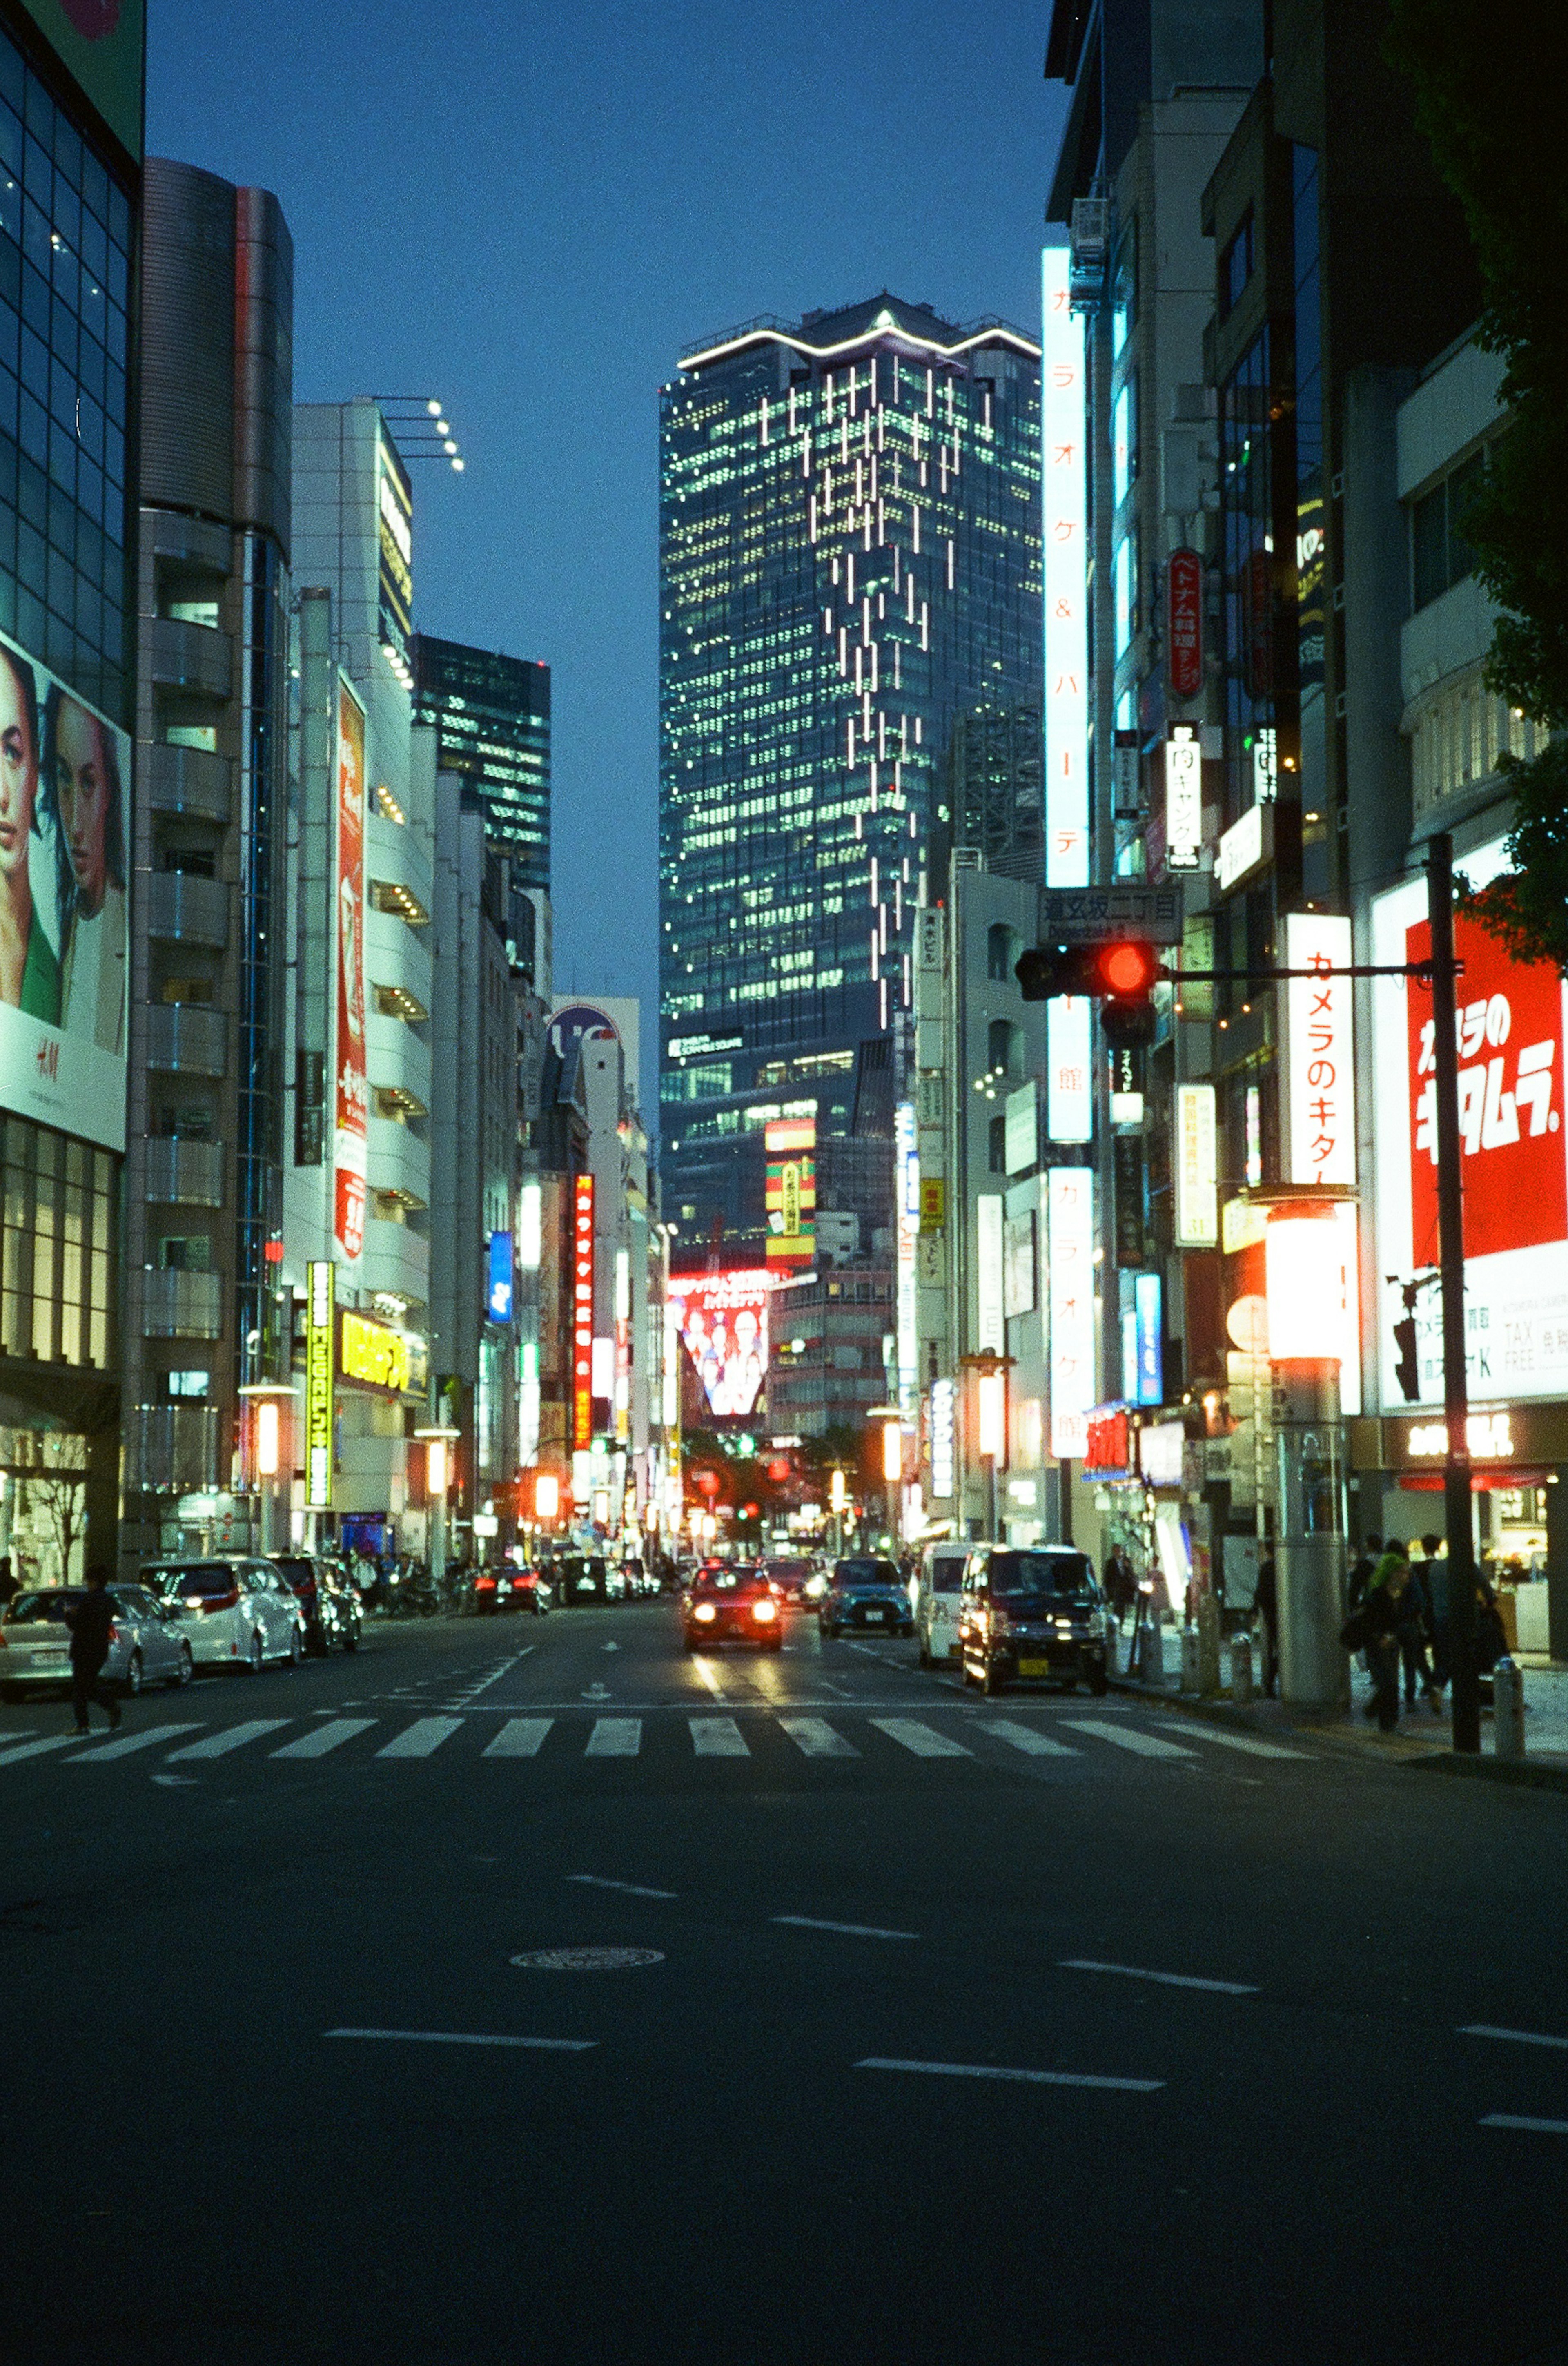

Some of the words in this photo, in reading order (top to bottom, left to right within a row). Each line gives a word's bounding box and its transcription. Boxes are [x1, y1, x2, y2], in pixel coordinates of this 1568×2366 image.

[1172, 749, 1194, 841] 肉ギャング
[1045, 894, 1174, 920] 道玄坂二丁目
[36, 1036, 59, 1082] H&M
[1418, 993, 1511, 1075] カラの
[1307, 951, 1337, 1184] カメラのキタ
[1056, 1185, 1083, 1439] カラオケ館
[1504, 1320, 1533, 1347] TAX
[1504, 1349, 1535, 1372] FREE
